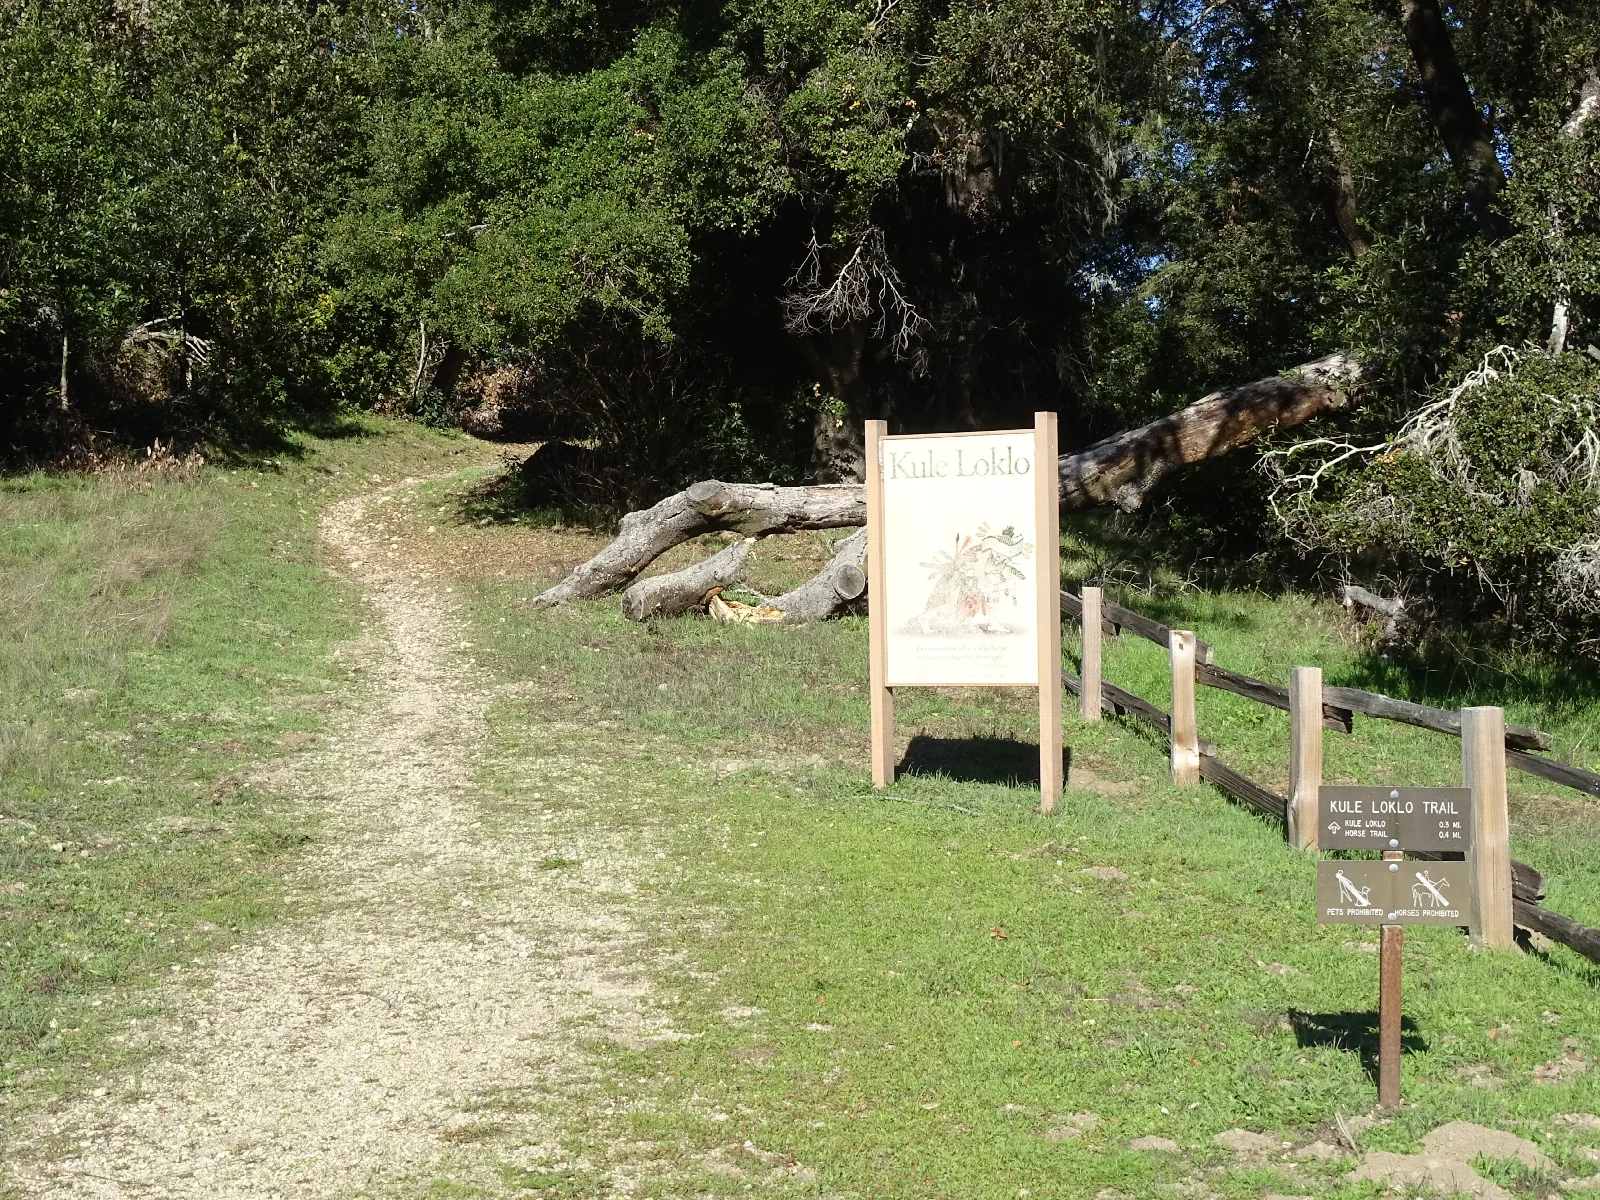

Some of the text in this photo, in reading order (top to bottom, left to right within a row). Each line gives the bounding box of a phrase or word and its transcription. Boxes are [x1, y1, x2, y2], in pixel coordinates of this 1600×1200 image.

[890, 446, 1030, 479] Kule Loklo
[1330, 800, 1459, 815] KULE LOKLO TRAIL
[1326, 908, 1384, 917] PETS PROHIBITED
[1394, 909, 1460, 918] HORSES PROHIBITED
